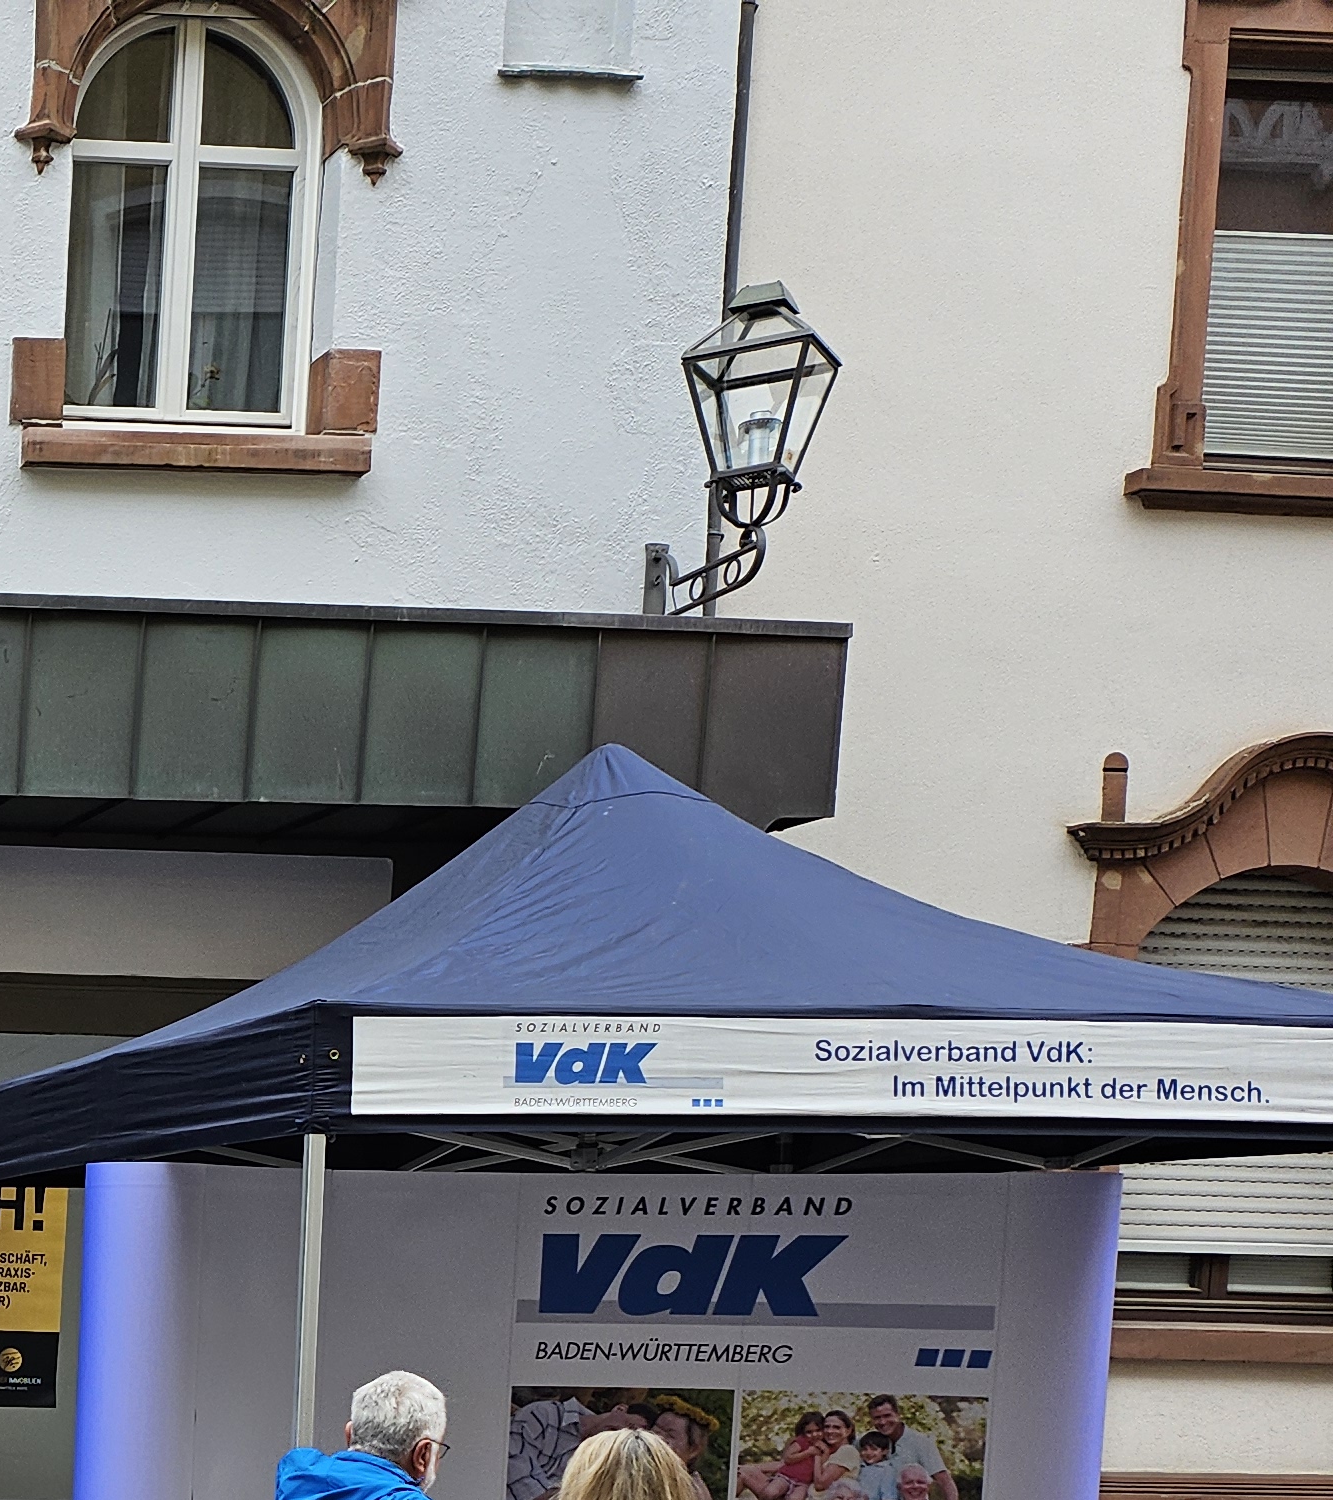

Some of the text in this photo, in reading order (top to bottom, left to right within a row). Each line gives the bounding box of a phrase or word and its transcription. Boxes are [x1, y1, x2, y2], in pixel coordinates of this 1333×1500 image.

[515, 1022, 662, 1034] SOZIALVERBAND
[514, 1042, 659, 1086] VdK
[815, 1039, 1094, 1064] Sozialverband VdK:
[514, 1096, 638, 1108] BADEN-WÜRTTEMBERG
[893, 1075, 1271, 1104] Im Mittelpunkt der Mensch.
[543, 1195, 854, 1217] SOZIALVERBAND
[538, 1233, 850, 1317] VdK
[534, 1337, 794, 1364] BADEN-WÜRTTEMBERG
